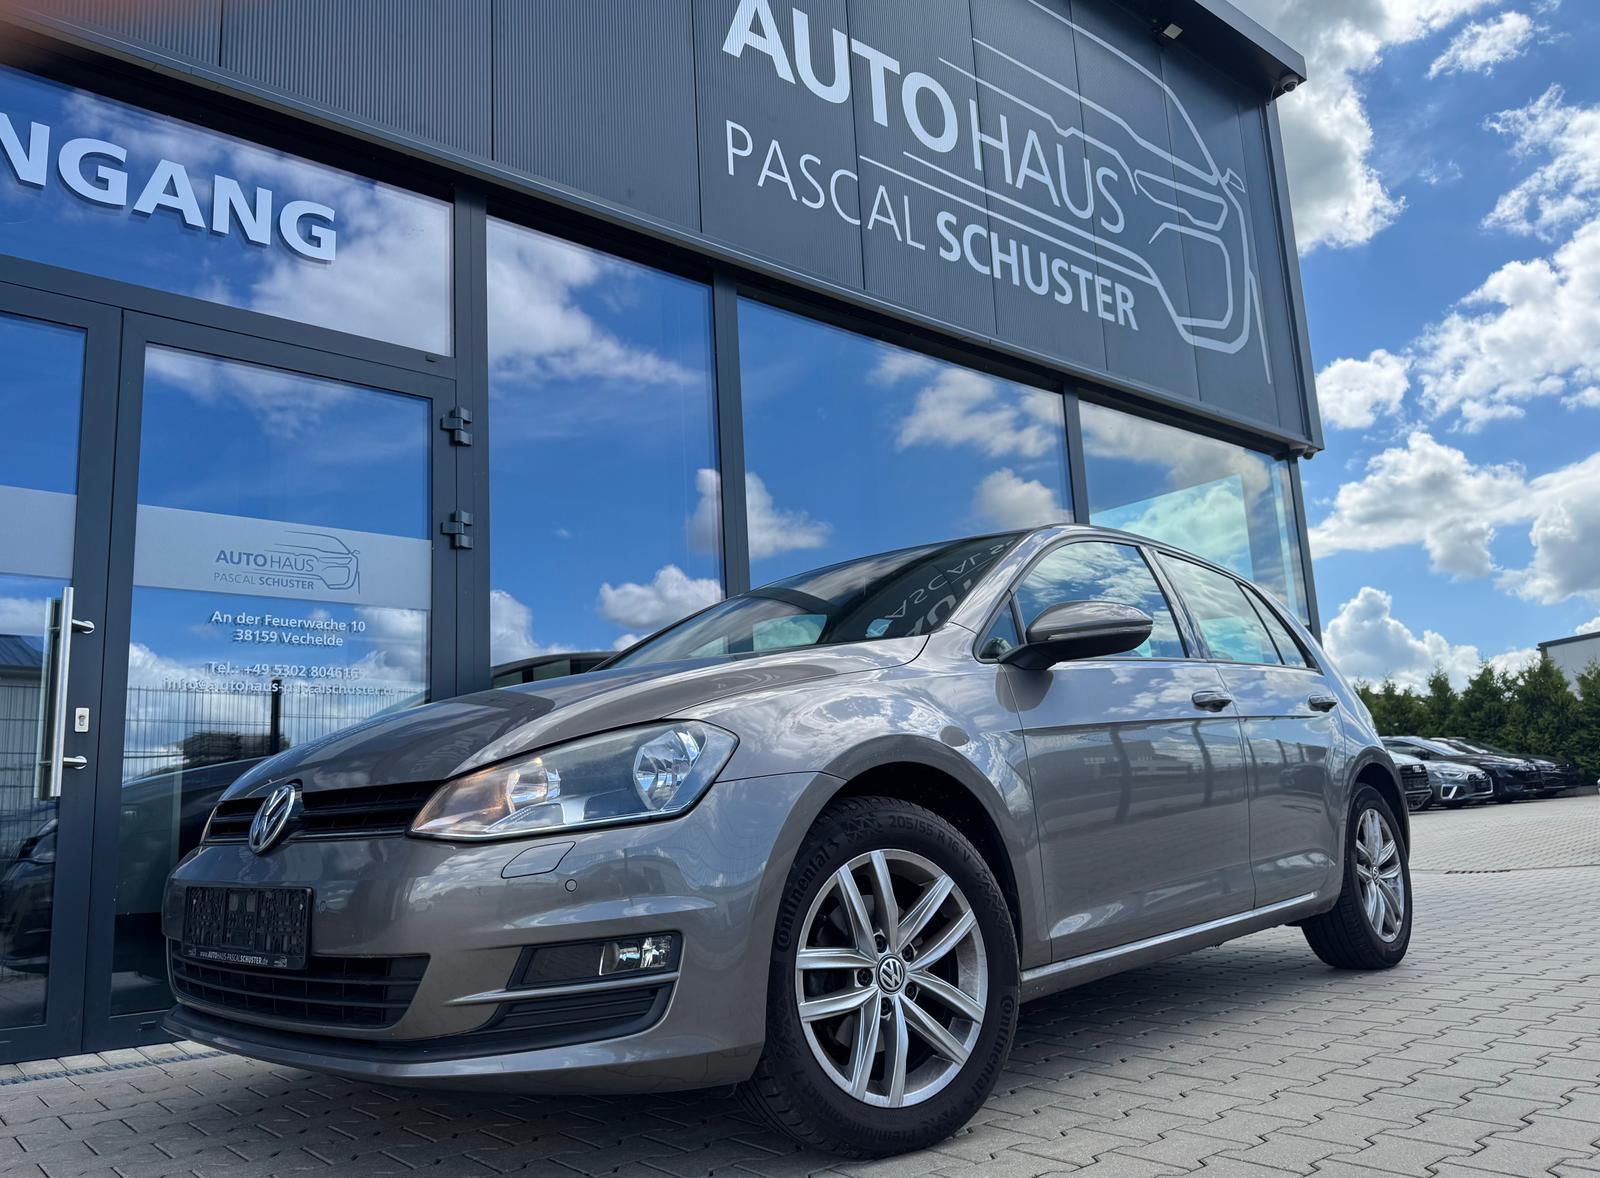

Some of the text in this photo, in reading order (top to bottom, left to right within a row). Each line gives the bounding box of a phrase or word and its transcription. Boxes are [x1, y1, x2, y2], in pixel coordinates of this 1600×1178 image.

[0, 112, 337, 261] NGANG
[726, 119, 1139, 331] PASCAL SCHUSTER
[214, 572, 314, 590] PASCAL SCHUSTER
[211, 610, 366, 632] An der Feuerwache 10
[236, 629, 344, 646] 38159 Vechelde
[245, 662, 270, 675] +49
[274, 664, 307, 678] 5302
[888, 815, 934, 836] 205/55
[937, 829, 946, 845] R
[776, 847, 831, 952] Continental
